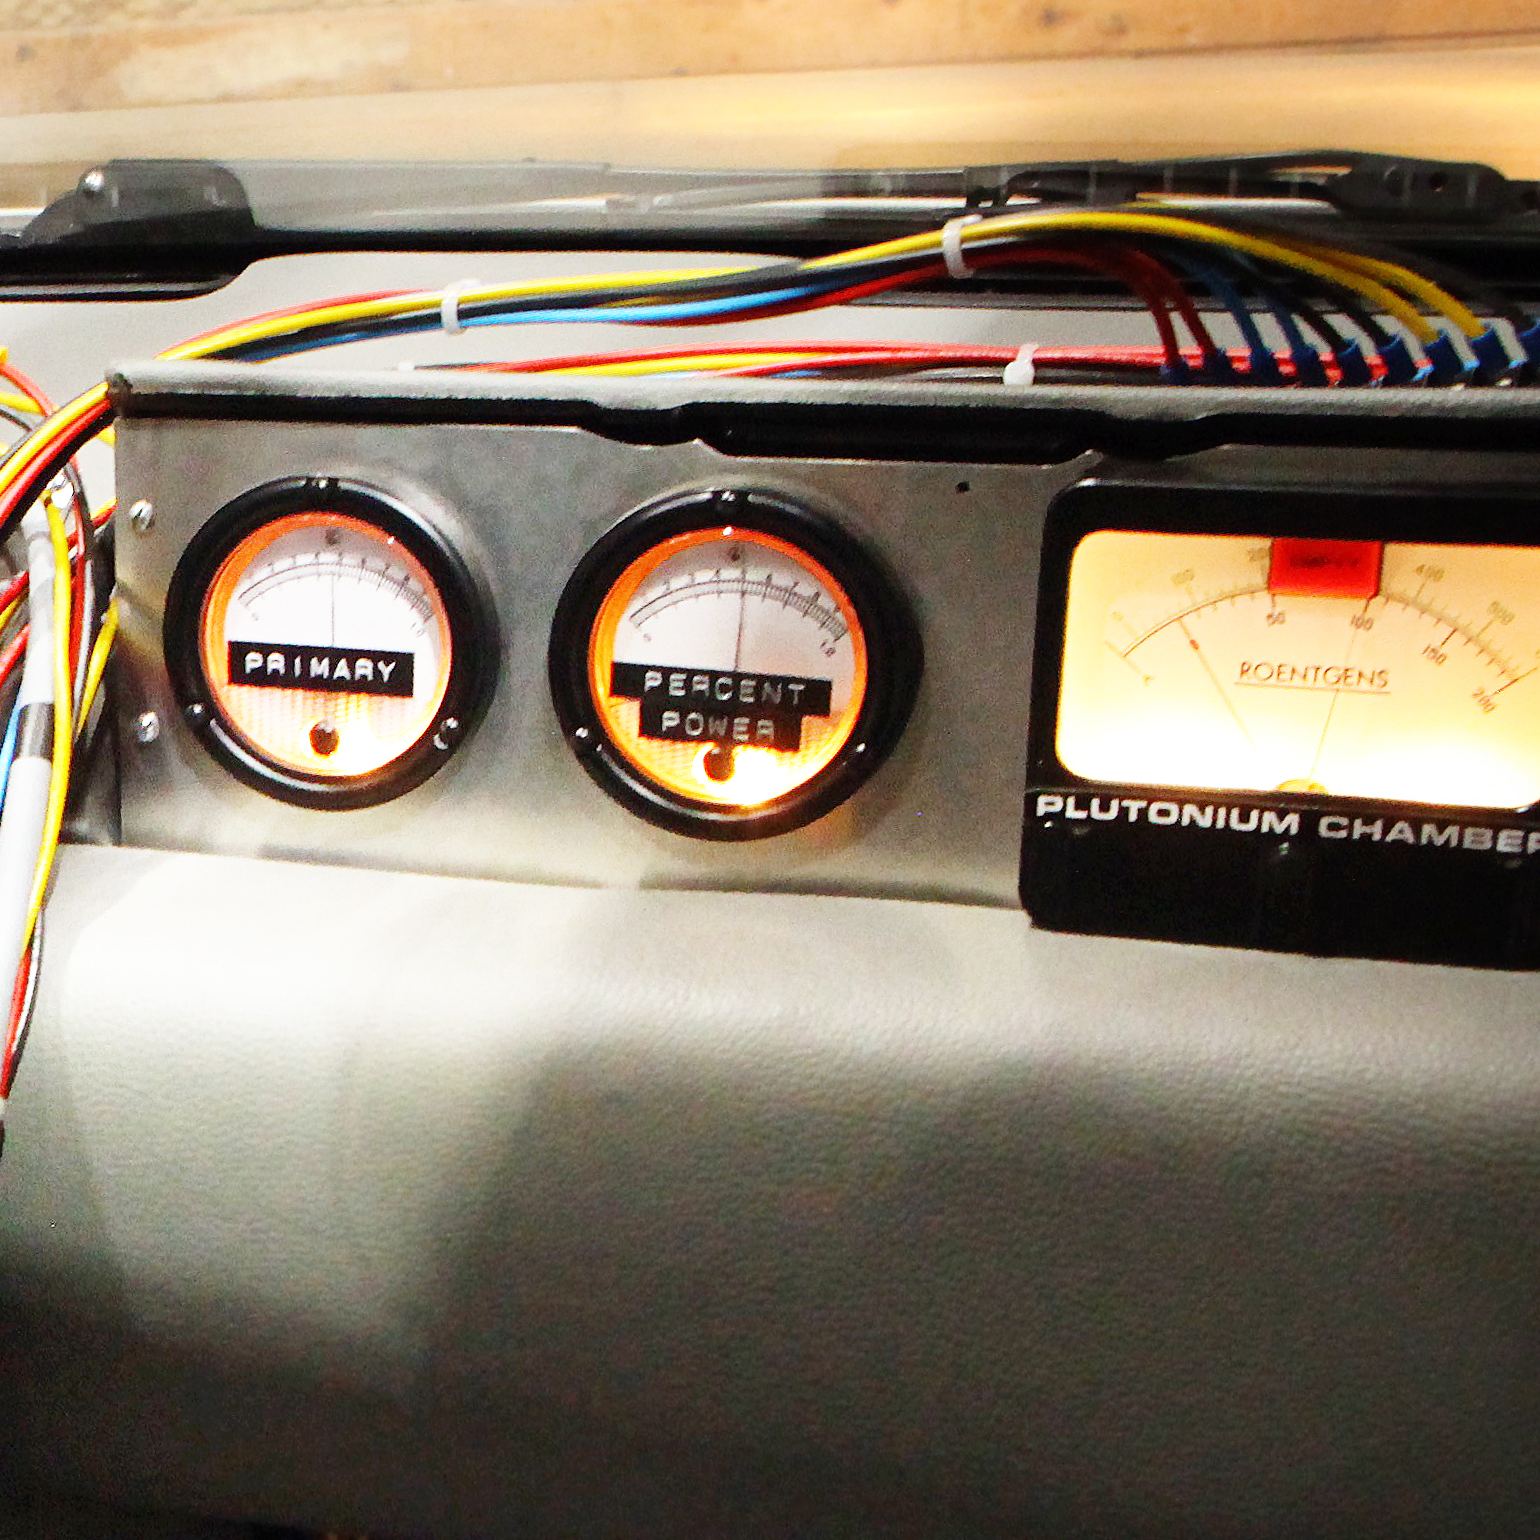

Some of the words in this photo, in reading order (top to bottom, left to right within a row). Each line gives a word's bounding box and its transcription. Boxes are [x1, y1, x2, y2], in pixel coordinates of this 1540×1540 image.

[1349, 614, 1375, 632] 100
[244, 651, 396, 683] PRIMARY
[1239, 660, 1390, 690] ROENTGENS
[643, 670, 806, 705] PERCENT
[661, 710, 776, 742] POWER
[1035, 794, 1300, 836] PLUTONIUM
